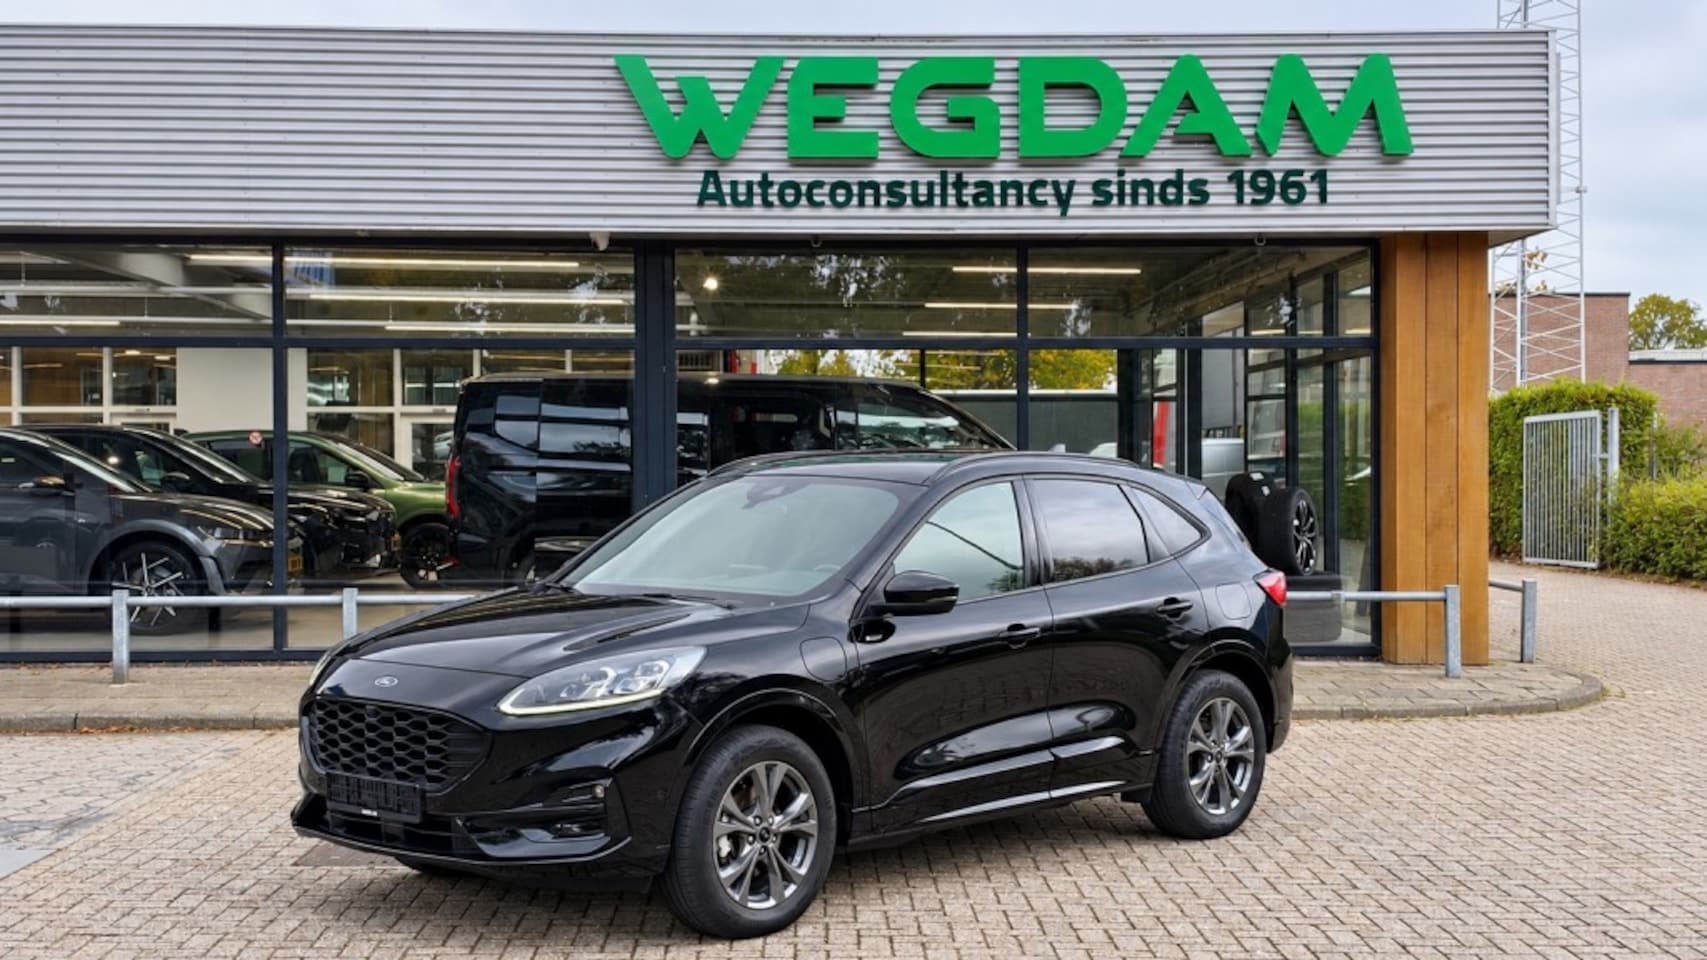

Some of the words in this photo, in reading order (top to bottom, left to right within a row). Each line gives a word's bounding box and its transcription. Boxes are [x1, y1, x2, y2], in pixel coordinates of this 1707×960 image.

[614, 53, 1414, 160] WEGDAM
[696, 169, 1076, 217] Autoconsultancy
[1091, 168, 1211, 207] sinds
[1227, 168, 1328, 206] 1961
